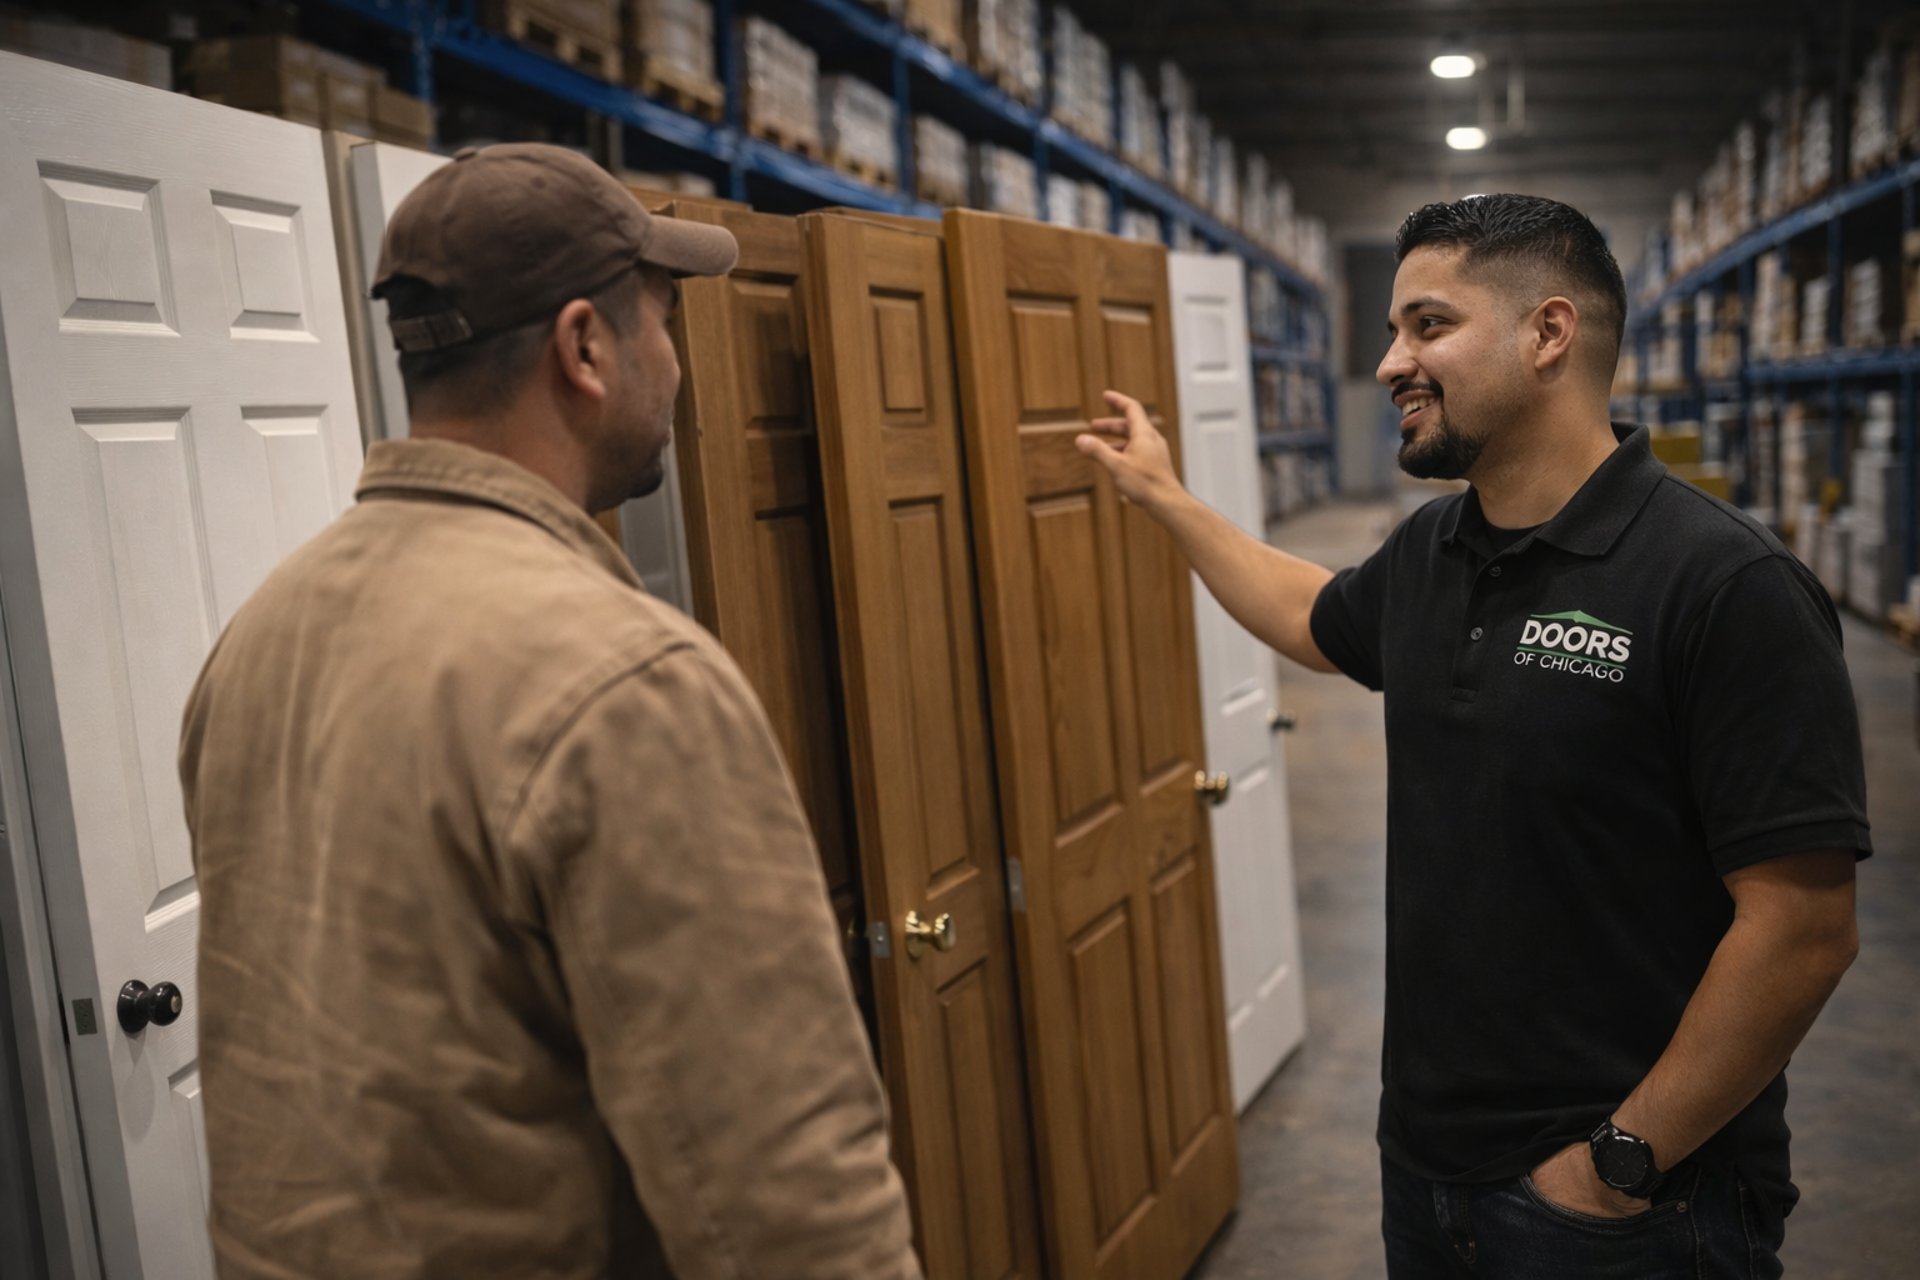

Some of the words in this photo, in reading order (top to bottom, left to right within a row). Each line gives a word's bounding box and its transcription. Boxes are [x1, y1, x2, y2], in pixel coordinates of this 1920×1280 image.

[1519, 619, 1632, 663] DOORS
[1513, 651, 1536, 666] OF
[1539, 654, 1624, 683] CHICAGO
